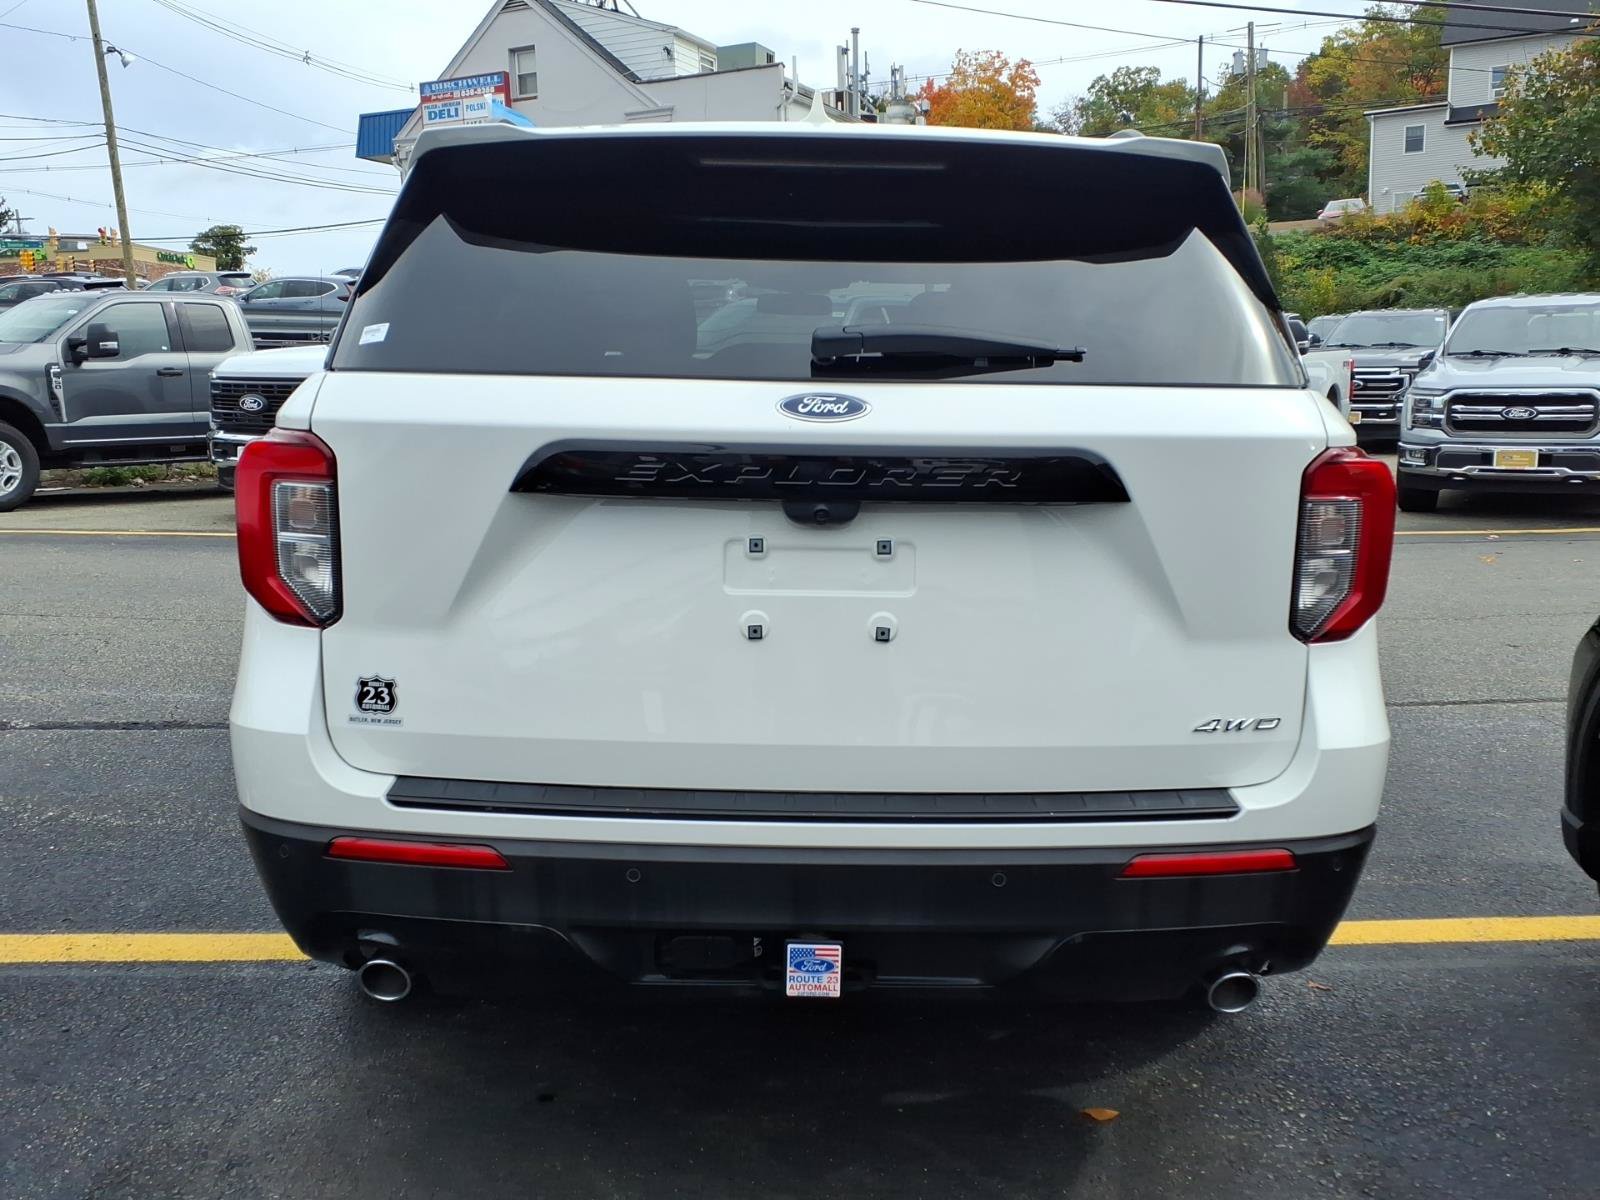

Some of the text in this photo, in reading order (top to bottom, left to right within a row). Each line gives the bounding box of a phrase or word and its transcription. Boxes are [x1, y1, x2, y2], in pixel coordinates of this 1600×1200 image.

[427, 108, 459, 120] DELI
[798, 396, 849, 414] Ford
[1508, 408, 1530, 417] Ford
[614, 462, 1022, 488] EXPLORER
[362, 686, 390, 704] 23
[1193, 717, 1281, 732] 4WD
[801, 960, 828, 972] Ford
[789, 975, 839, 984] ROUTE 23
